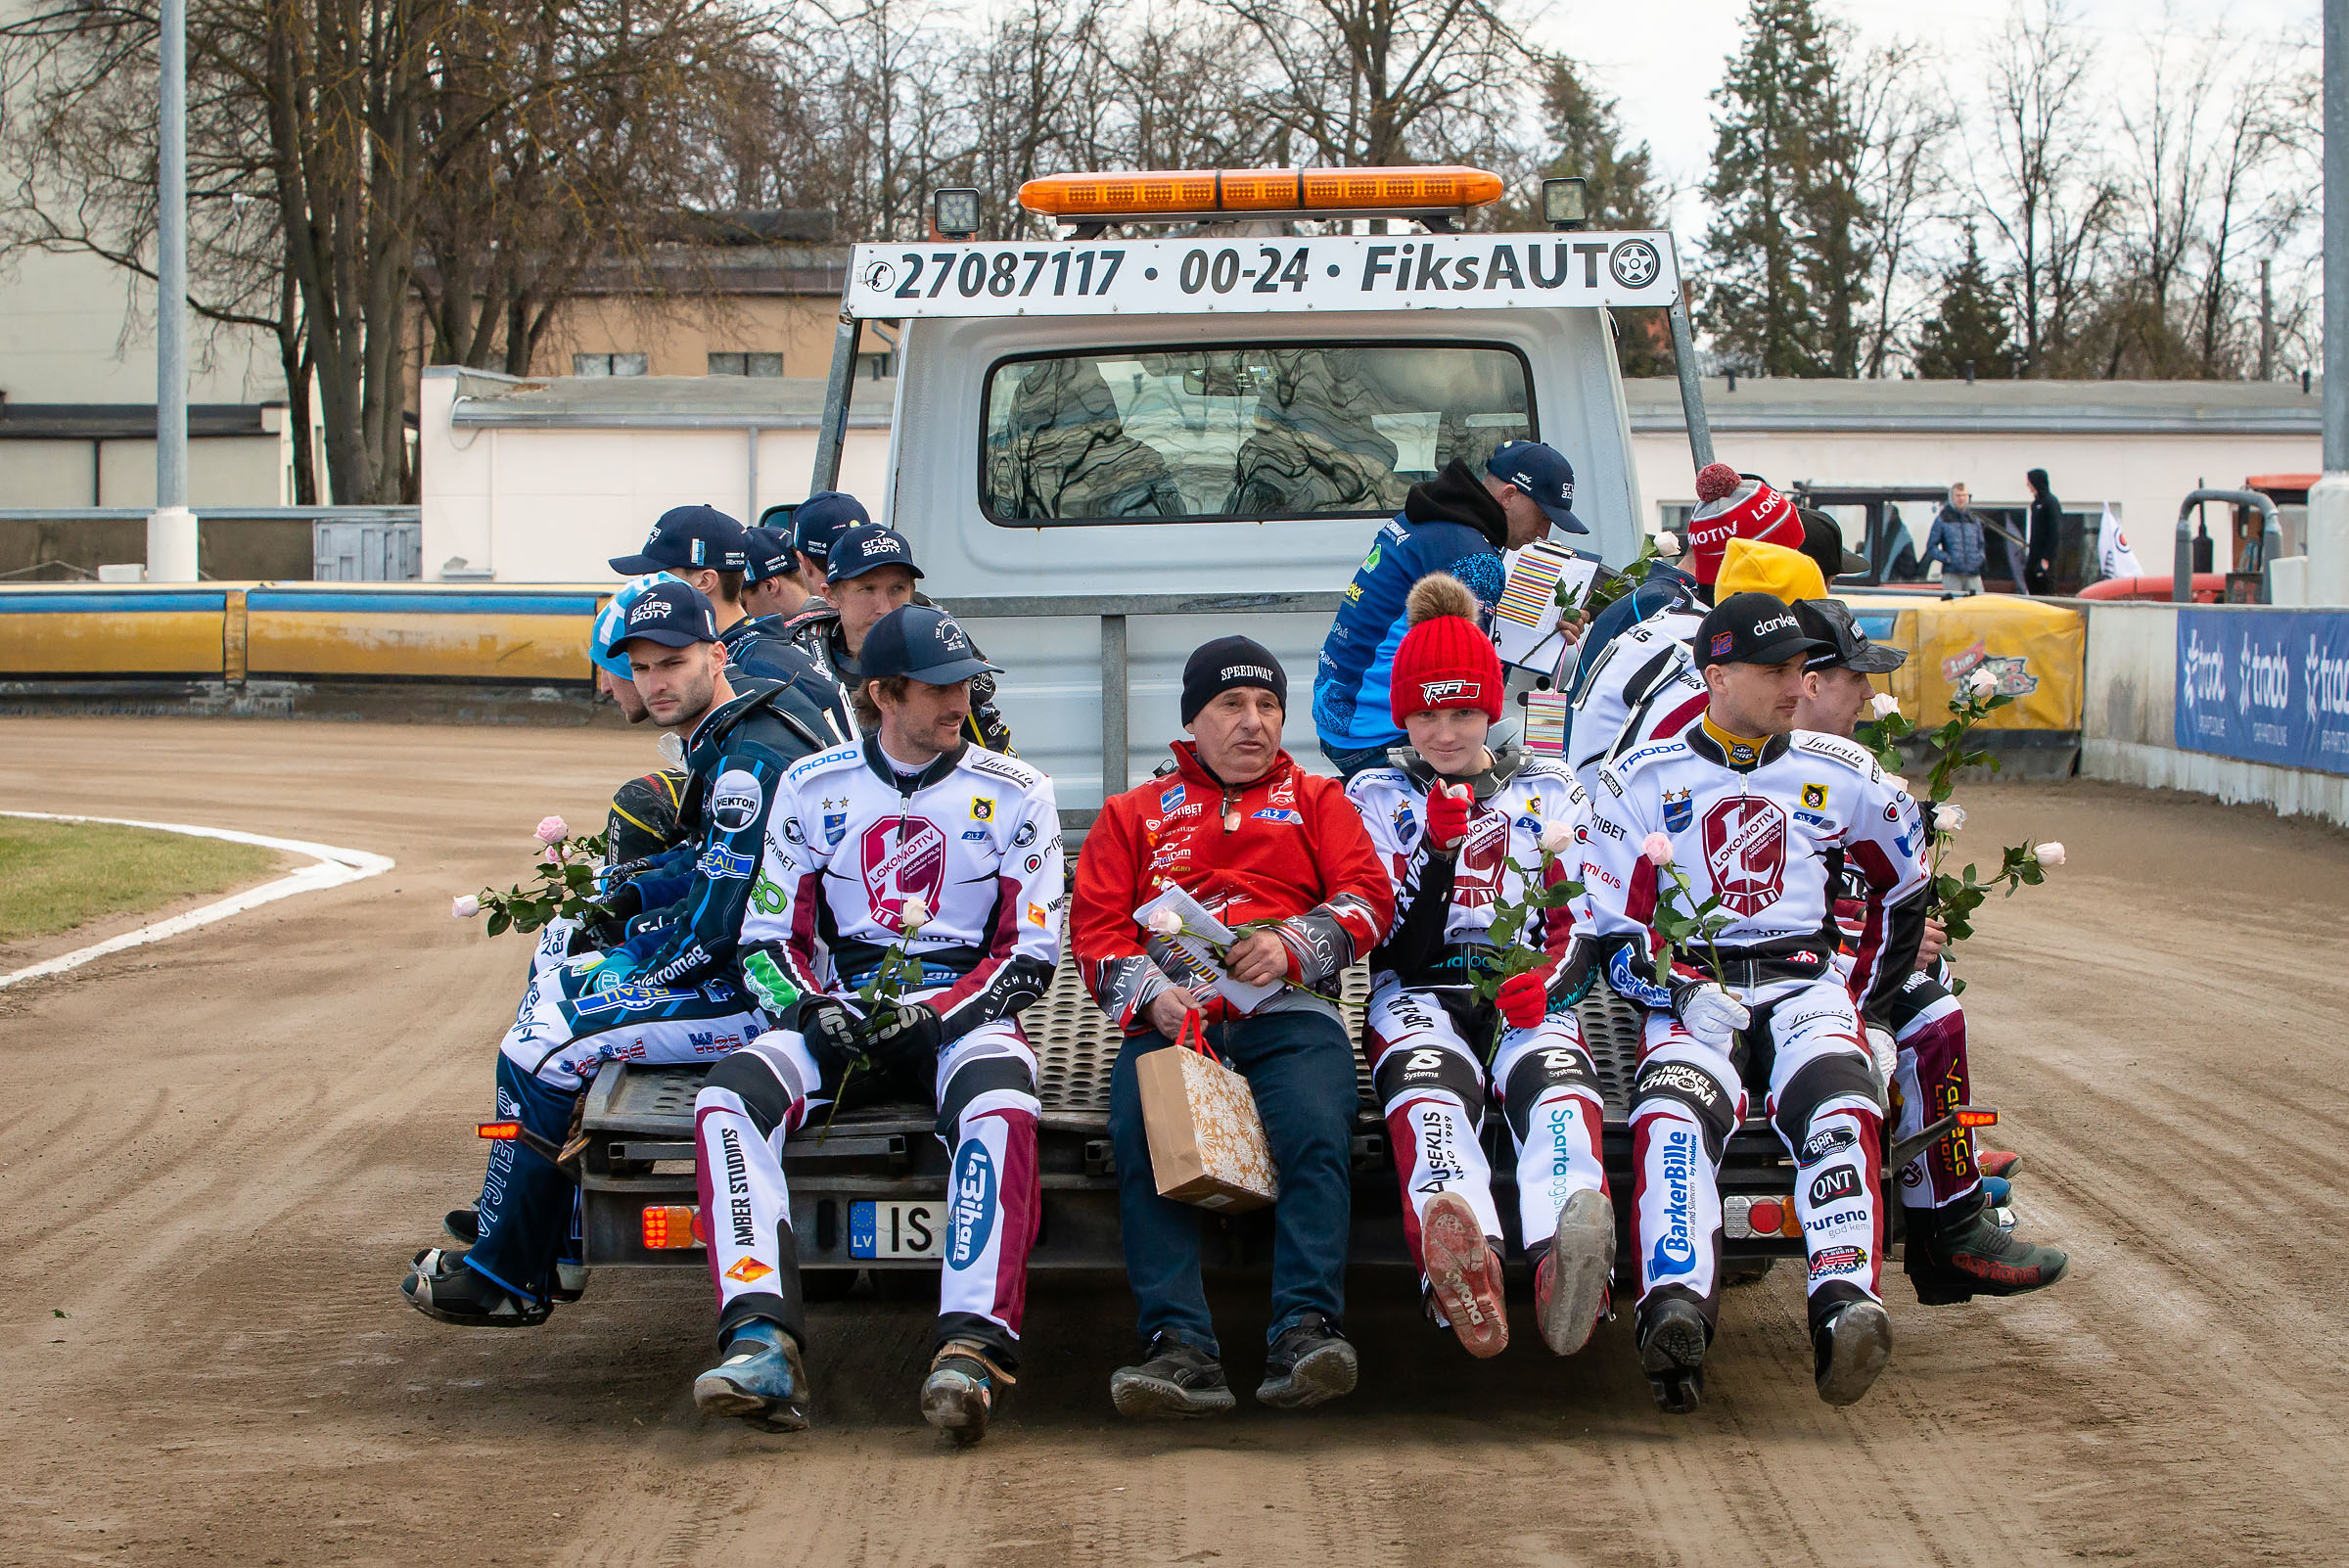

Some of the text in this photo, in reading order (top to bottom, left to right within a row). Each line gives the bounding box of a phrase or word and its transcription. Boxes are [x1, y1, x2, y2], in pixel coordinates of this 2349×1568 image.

[895, 251, 1125, 300] 27087117
[1179, 247, 1309, 294] 00-24
[1710, 631, 1733, 656] 12
[1221, 665, 1274, 682] SPEEDWAY
[1618, 742, 1687, 773] TRODO
[1793, 731, 1865, 764] Interio
[789, 750, 858, 782] TRODO
[970, 751, 1035, 785] Interio
[1351, 773, 1406, 795] TRODO
[716, 797, 756, 810] HEKTOR
[1163, 803, 1203, 822] OPTIBET
[1591, 811, 1628, 843] PTIBET
[1713, 807, 1774, 868] LOKOMOTIV
[870, 830, 934, 884] LOKOMOTIV
[1404, 1072, 1440, 1081] Systems
[1547, 1067, 1584, 1078] Systems
[1661, 1065, 1711, 1091] NIKKEL
[1639, 1074, 1716, 1107] CHROM
[1415, 1111, 1451, 1194] AUSEKLIS
[1547, 1109, 1574, 1206] Spartalogis
[1809, 1131, 1835, 1155] BAR
[1689, 1166, 1697, 1176] by
[1813, 1169, 1854, 1200] QNT
[478, 1137, 516, 1238] ELICJA
[721, 1128, 756, 1247] AMBER STUDIOS
[1664, 1130, 1689, 1253] BarkerBille
[891, 1207, 933, 1253] IS
[1803, 1210, 1867, 1235] Pureno
[1828, 1224, 1848, 1240] god
[852, 1234, 873, 1248] LV
